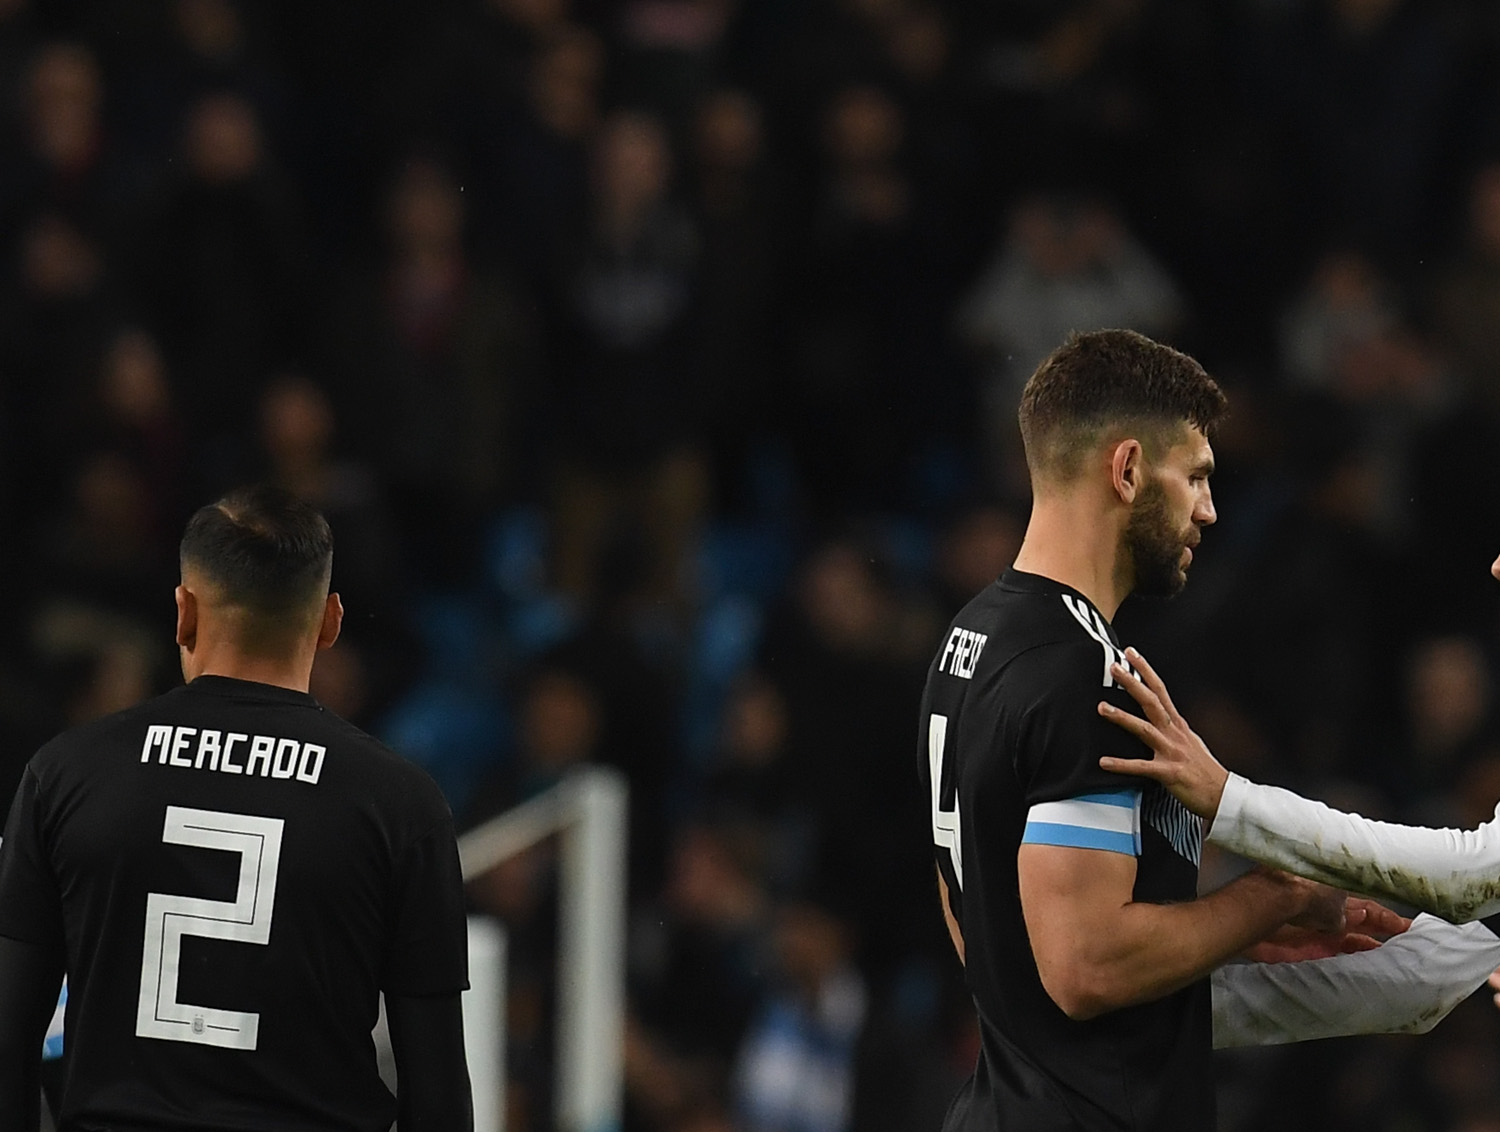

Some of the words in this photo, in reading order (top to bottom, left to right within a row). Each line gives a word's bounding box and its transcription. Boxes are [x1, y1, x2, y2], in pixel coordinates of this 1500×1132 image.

[141, 725, 326, 784] MERCADO
[929, 713, 963, 893] 4
[136, 805, 285, 1050] 2
